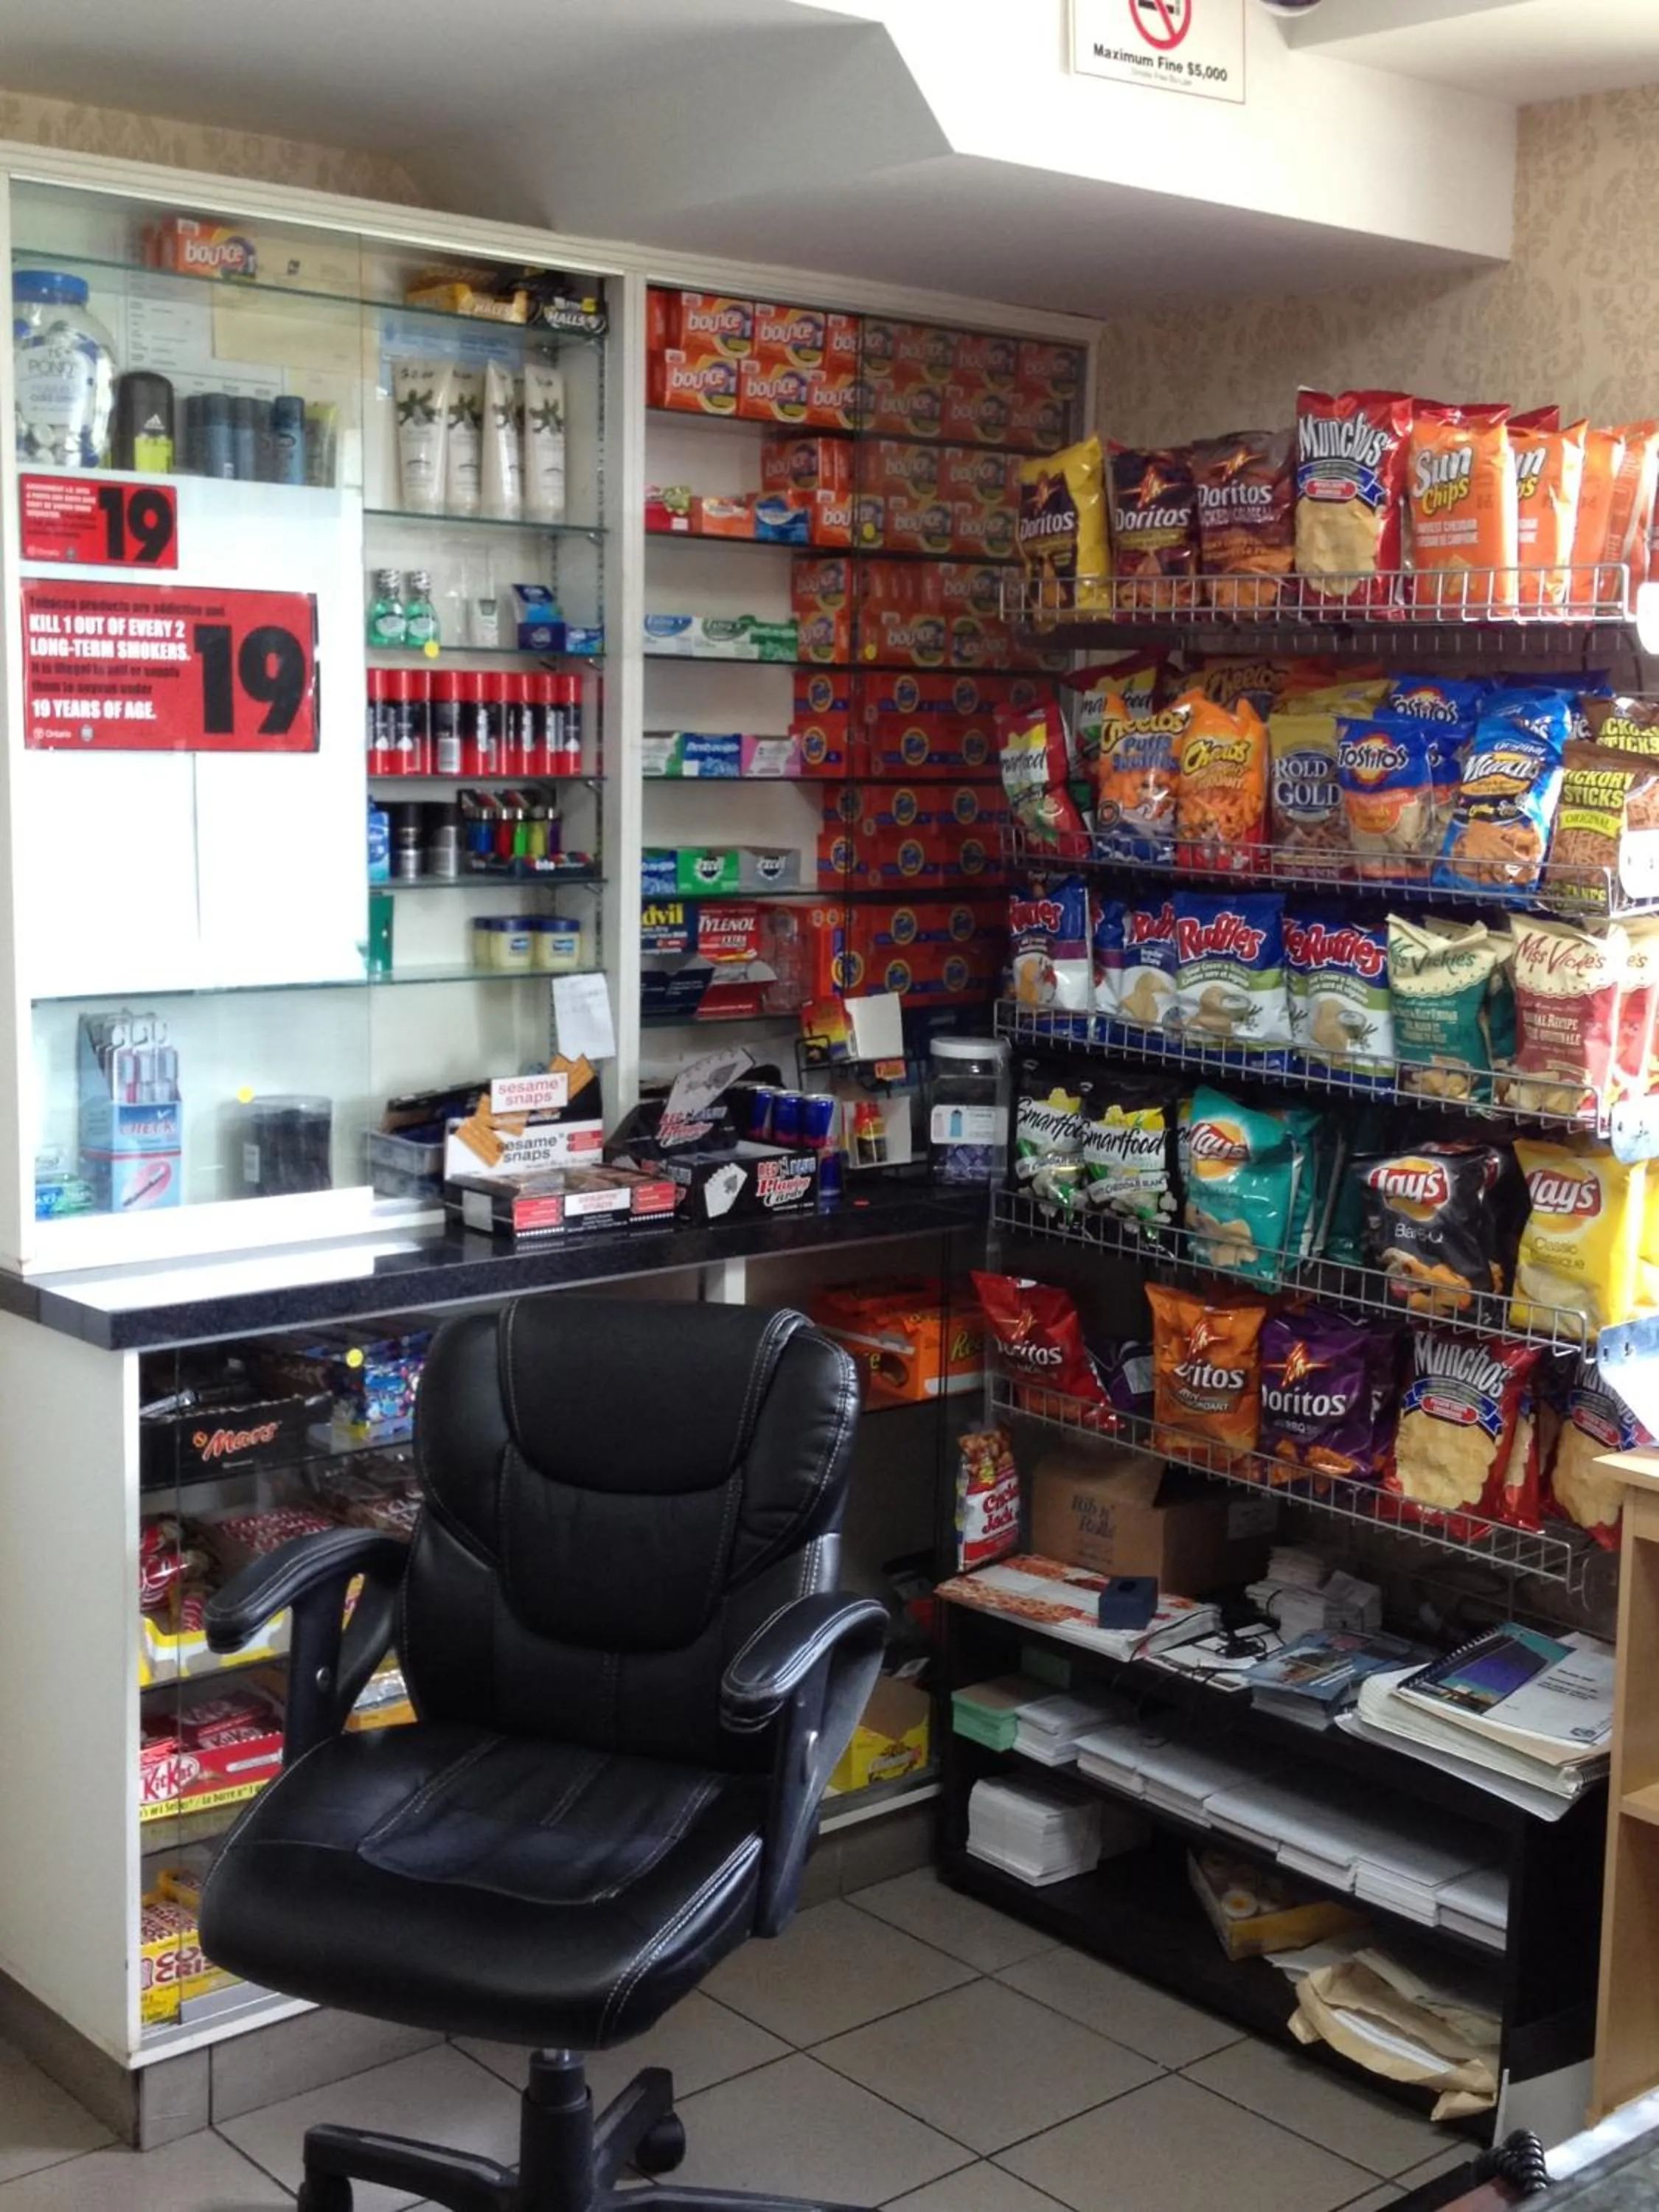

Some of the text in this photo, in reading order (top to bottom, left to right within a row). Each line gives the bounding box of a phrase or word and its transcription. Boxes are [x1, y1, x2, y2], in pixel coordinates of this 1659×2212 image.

[1093, 43, 1228, 82] Maximum Fine $5,000
[546, 311, 585, 327] HALLS
[1413, 445, 1473, 497] Sun
[1198, 479, 1273, 509] Doritos
[1422, 473, 1469, 515] Chips
[98, 486, 174, 563] 19
[1020, 509, 1075, 540] Doritos
[1116, 504, 1192, 532] Doritos
[29, 613, 186, 639] KILL 1 OUT OF EVERY 2
[29, 637, 192, 661] LONG-TERM SMOKERS.
[192, 622, 307, 736] 19
[32, 698, 157, 720] 19 YEARS OF AGE.
[1391, 693, 1460, 726] Tostitos
[1275, 759, 1328, 779] ROLD
[1338, 740, 1409, 771] Tostitos
[1274, 779, 1345, 808] GOLD
[1564, 784, 1624, 809] STICKS
[641, 902, 684, 926] dvil
[699, 914, 756, 933] TYLENOL
[1177, 911, 1267, 964] Ruffles
[1307, 923, 1388, 978] Ruffles
[1515, 932, 1547, 973] Miss
[498, 1077, 559, 1096] sesame
[506, 1091, 553, 1110] snaps
[503, 1147, 551, 1164] snaps
[1080, 1120, 1169, 1161] Smartfood
[1529, 1170, 1596, 1214] Lay's
[1174, 1358, 1246, 1390] ritos
[1413, 1330, 1512, 1399] Munchos
[201, 1420, 283, 1462] Mars
